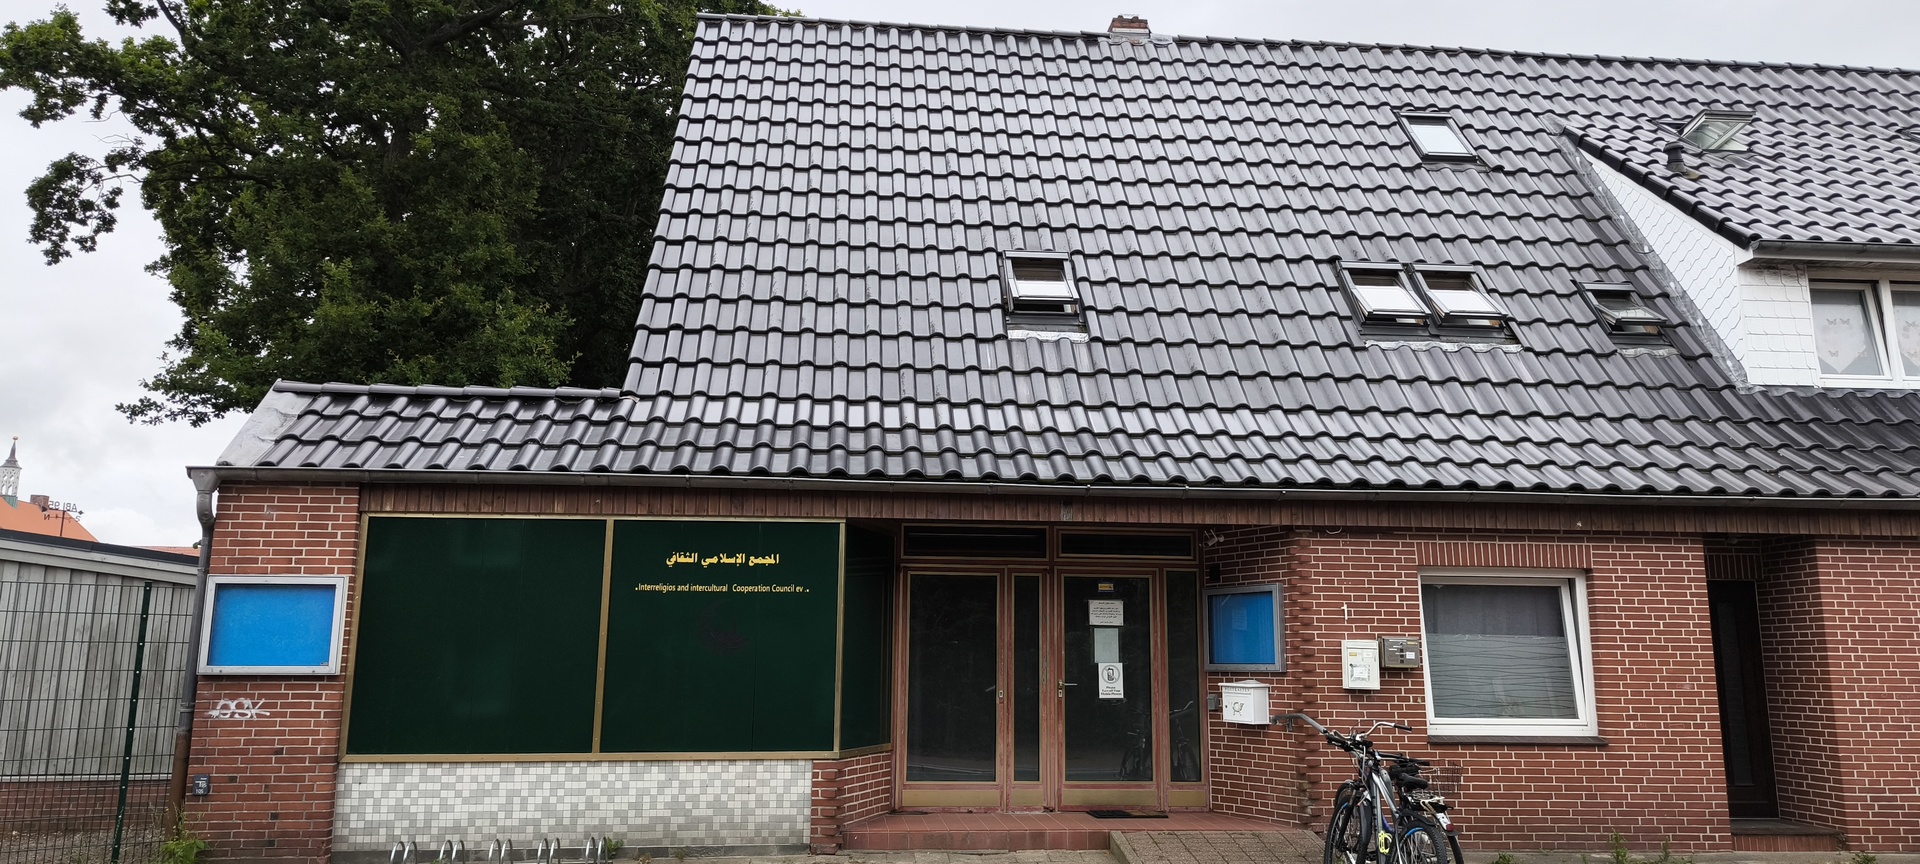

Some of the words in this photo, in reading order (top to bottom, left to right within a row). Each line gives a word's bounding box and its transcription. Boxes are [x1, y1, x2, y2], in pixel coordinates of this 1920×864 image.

[666, 552, 698, 567] الثقافي
[701, 553, 746, 568] الإسلامي
[749, 553, 780, 567] المجمع
[677, 584, 690, 592] and
[690, 583, 728, 592] intercultural
[732, 584, 770, 594] Cooperation
[771, 584, 795, 593] Council
